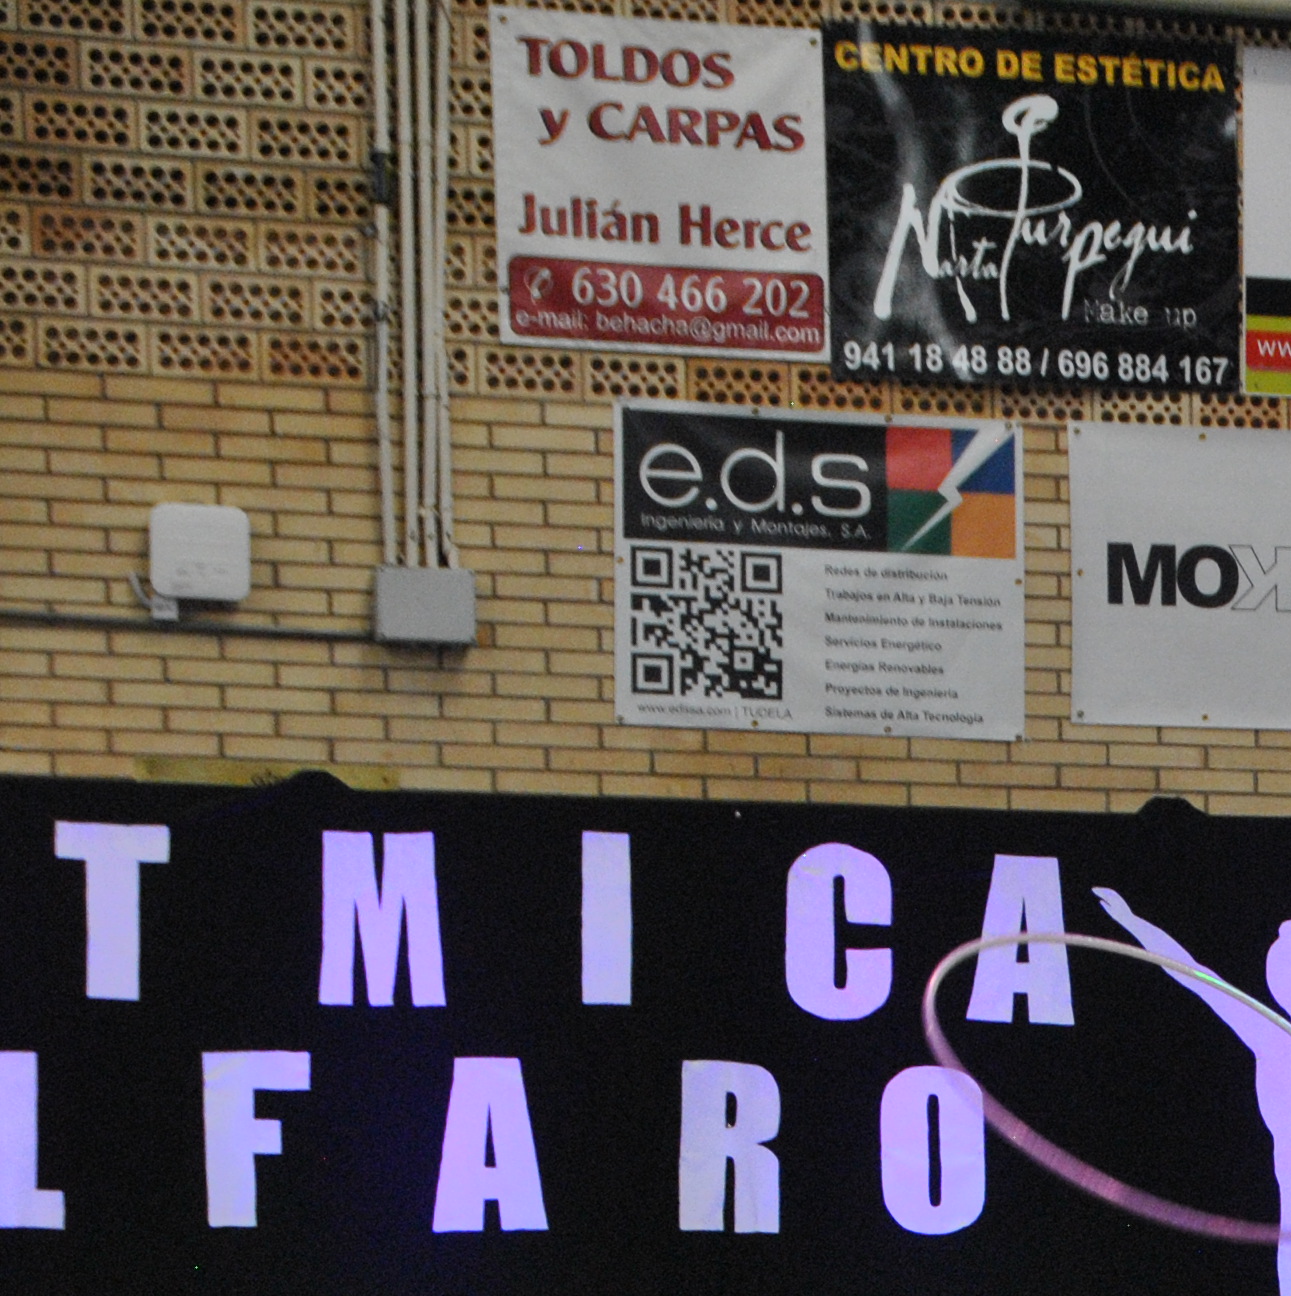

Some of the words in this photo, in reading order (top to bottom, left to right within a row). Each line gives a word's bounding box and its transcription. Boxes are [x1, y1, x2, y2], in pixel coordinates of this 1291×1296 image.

[516, 36, 735, 90] TOLDOS
[834, 40, 985, 78] CENTRO
[997, 49, 1043, 82] DE
[1054, 52, 1227, 93] ESTÉTICA
[537, 108, 570, 146] y
[587, 102, 806, 153] CARPAS
[518, 192, 660, 244] Julián
[678, 203, 813, 253] Herce
[571, 267, 644, 309] 630
[657, 273, 728, 313] 466
[742, 277, 811, 319] 202
[516, 309, 588, 331] e-mail:
[1084, 298, 1150, 326] Make
[1165, 306, 1197, 330] up
[844, 340, 895, 371] 941
[909, 342, 943, 373] 18
[952, 347, 988, 375] 48
[997, 347, 1032, 377] 88
[1058, 349, 1110, 380] 696
[1118, 352, 1170, 383] 884
[1179, 355, 1229, 386] 167
[639, 429, 873, 518] e.d.s
[733, 518, 744, 535] y
[824, 563, 860, 578] Redes
[864, 565, 878, 579] de
[825, 587, 874, 604] Trabajos
[892, 591, 916, 604] Alta
[928, 592, 955, 609] Baja
[824, 611, 909, 628] Mantenimiento
[911, 616, 926, 628] de
[928, 615, 1004, 632] Instalaciones
[824, 634, 878, 650] Servicios
[878, 661, 945, 676] Renovables
[824, 681, 883, 698] Proyectos
[885, 685, 900, 698] de
[742, 704, 794, 721] TUDELA
[824, 705, 878, 721] Sistemas
[880, 708, 895, 721] de
[896, 708, 920, 722] Alta
